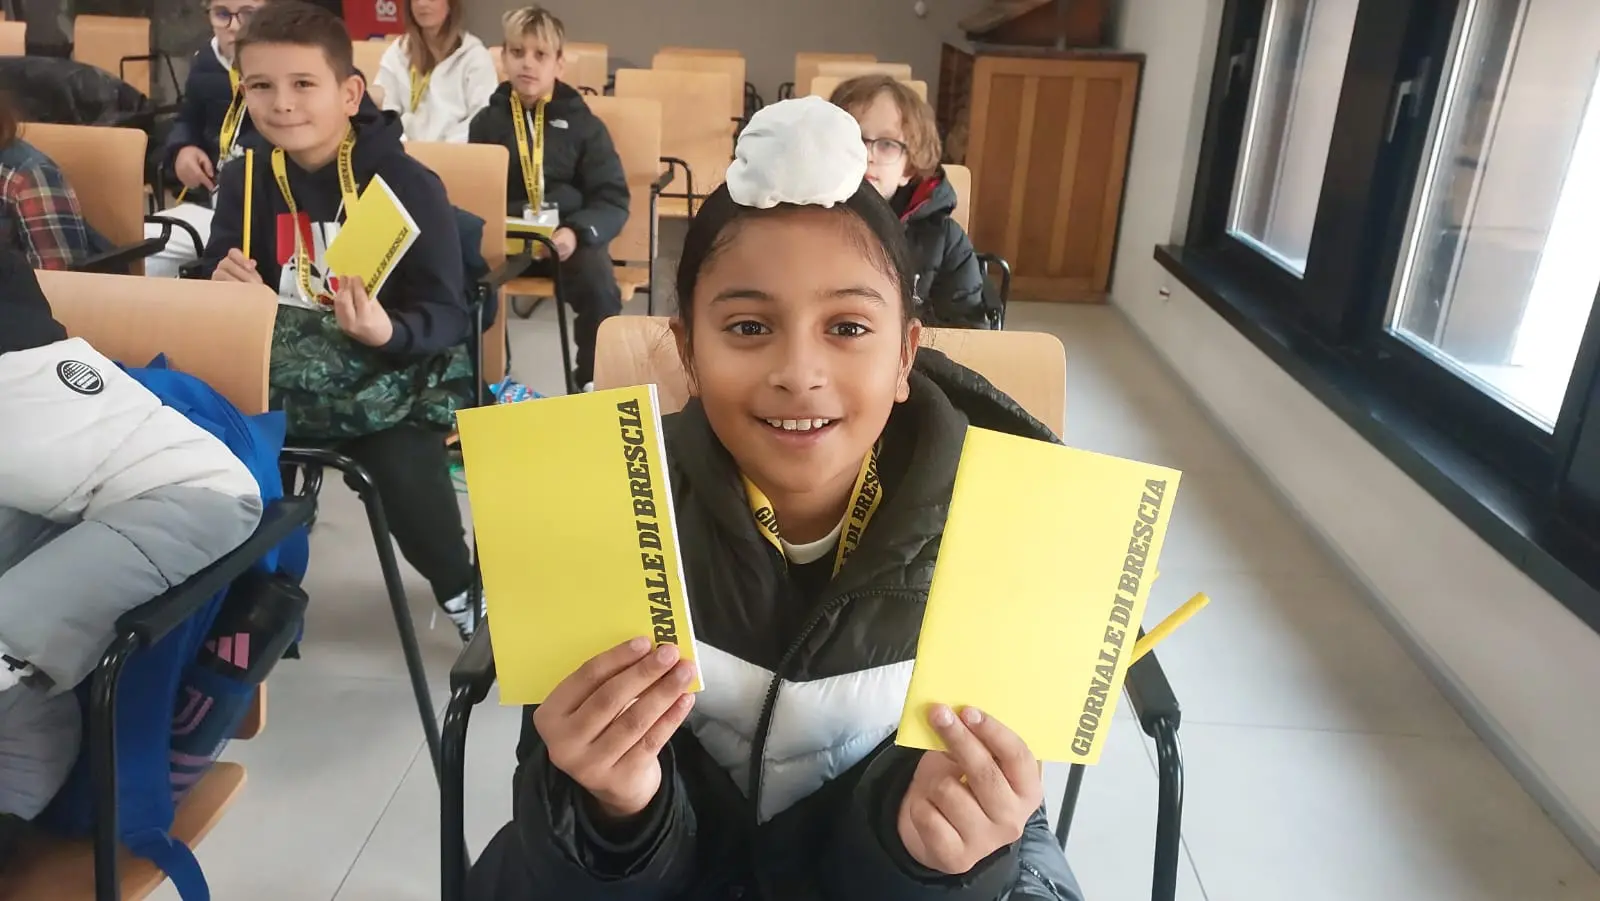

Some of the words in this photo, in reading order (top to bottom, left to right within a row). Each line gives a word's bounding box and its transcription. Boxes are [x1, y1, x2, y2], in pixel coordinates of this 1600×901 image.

[616, 398, 657, 519] BRESCIA
[636, 520, 664, 553] DI
[846, 523, 862, 546] DI
[1117, 479, 1167, 597] BRESCIA
[641, 552, 679, 649] RNALE
[1109, 594, 1136, 629] DI
[1071, 625, 1126, 757] GIORNALE
